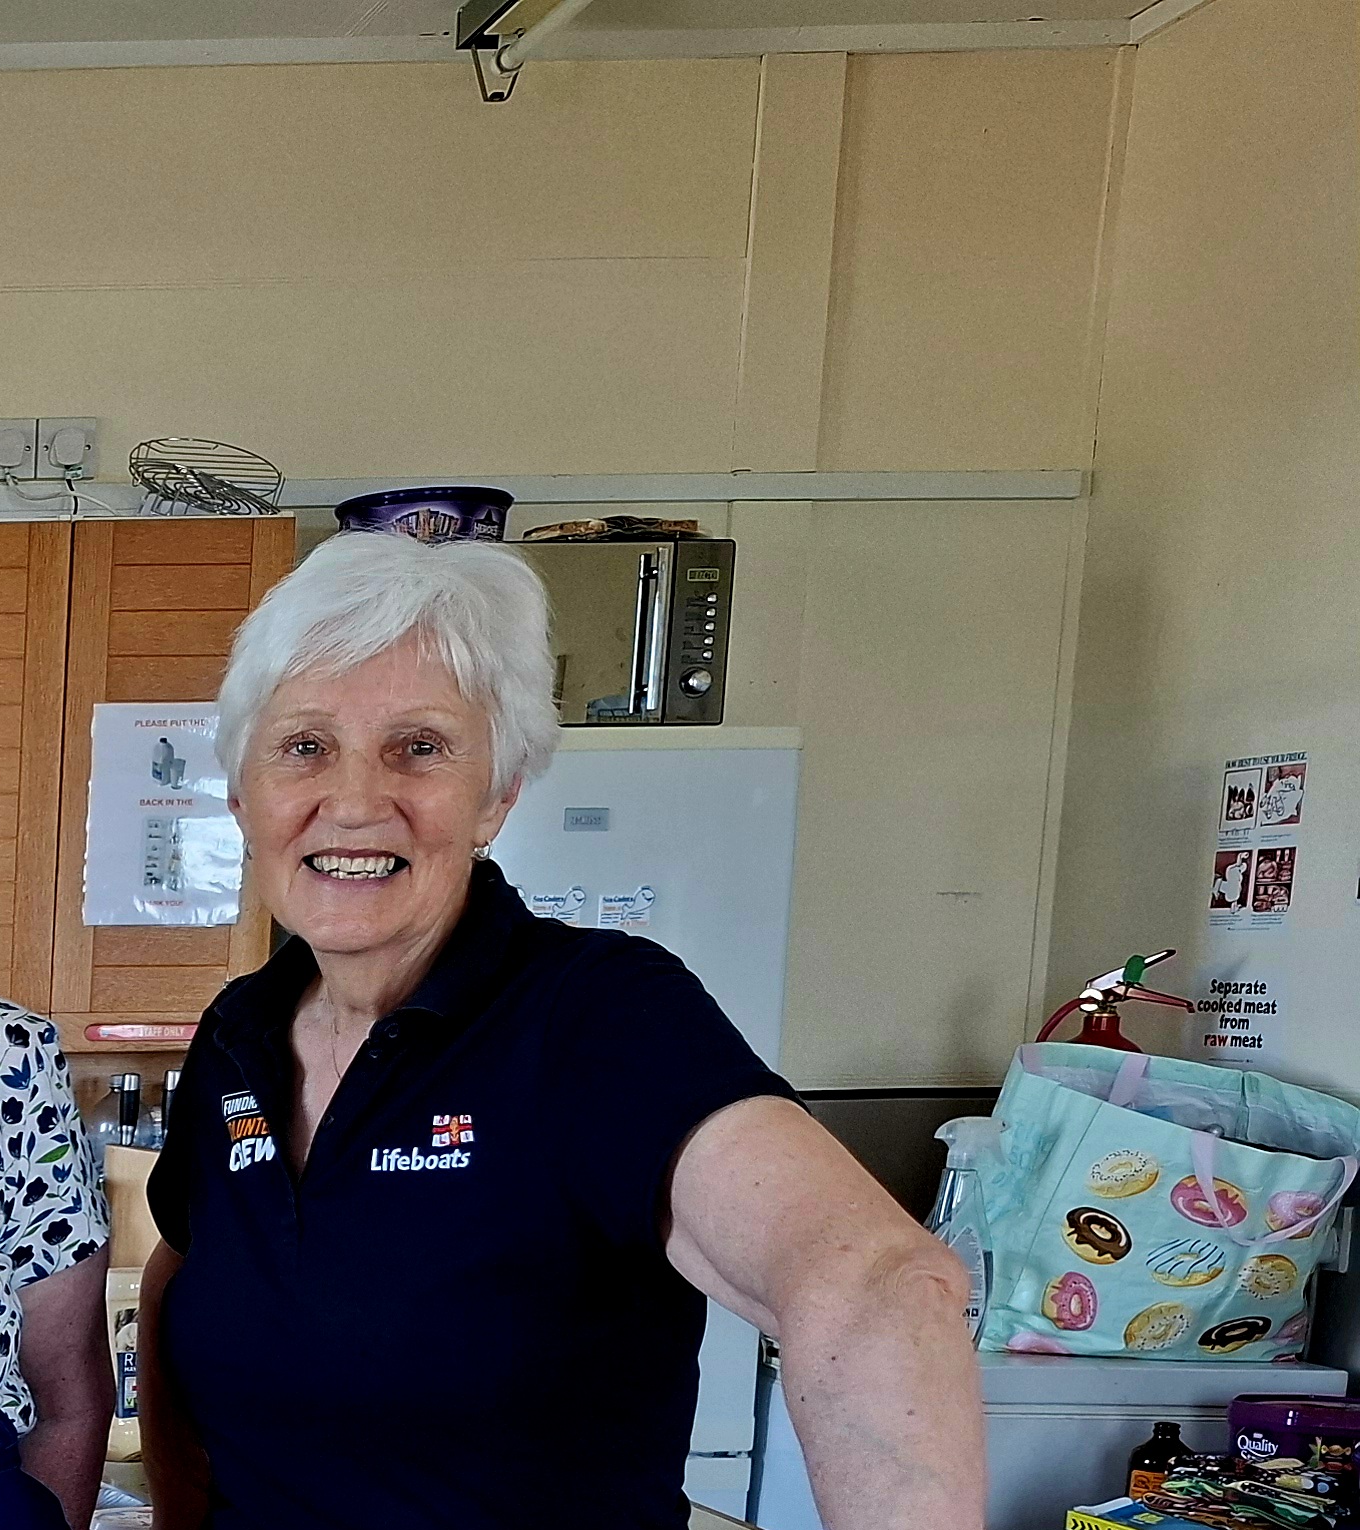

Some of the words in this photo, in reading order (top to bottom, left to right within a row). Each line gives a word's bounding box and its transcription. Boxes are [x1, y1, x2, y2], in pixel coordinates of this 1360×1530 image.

[134, 719, 168, 727] PLEASE
[170, 719, 188, 727] PUT
[1209, 978, 1267, 999] Separate
[1197, 998, 1243, 1013] cooked
[1243, 999, 1278, 1015] meat
[1219, 1014, 1250, 1030] from
[163, 1027, 185, 1037] ONLY
[1203, 1034, 1228, 1047] raw
[1229, 1033, 1263, 1049] meat
[370, 1146, 471, 1172] Lifeboats
[1237, 1435, 1279, 1457] Quality
